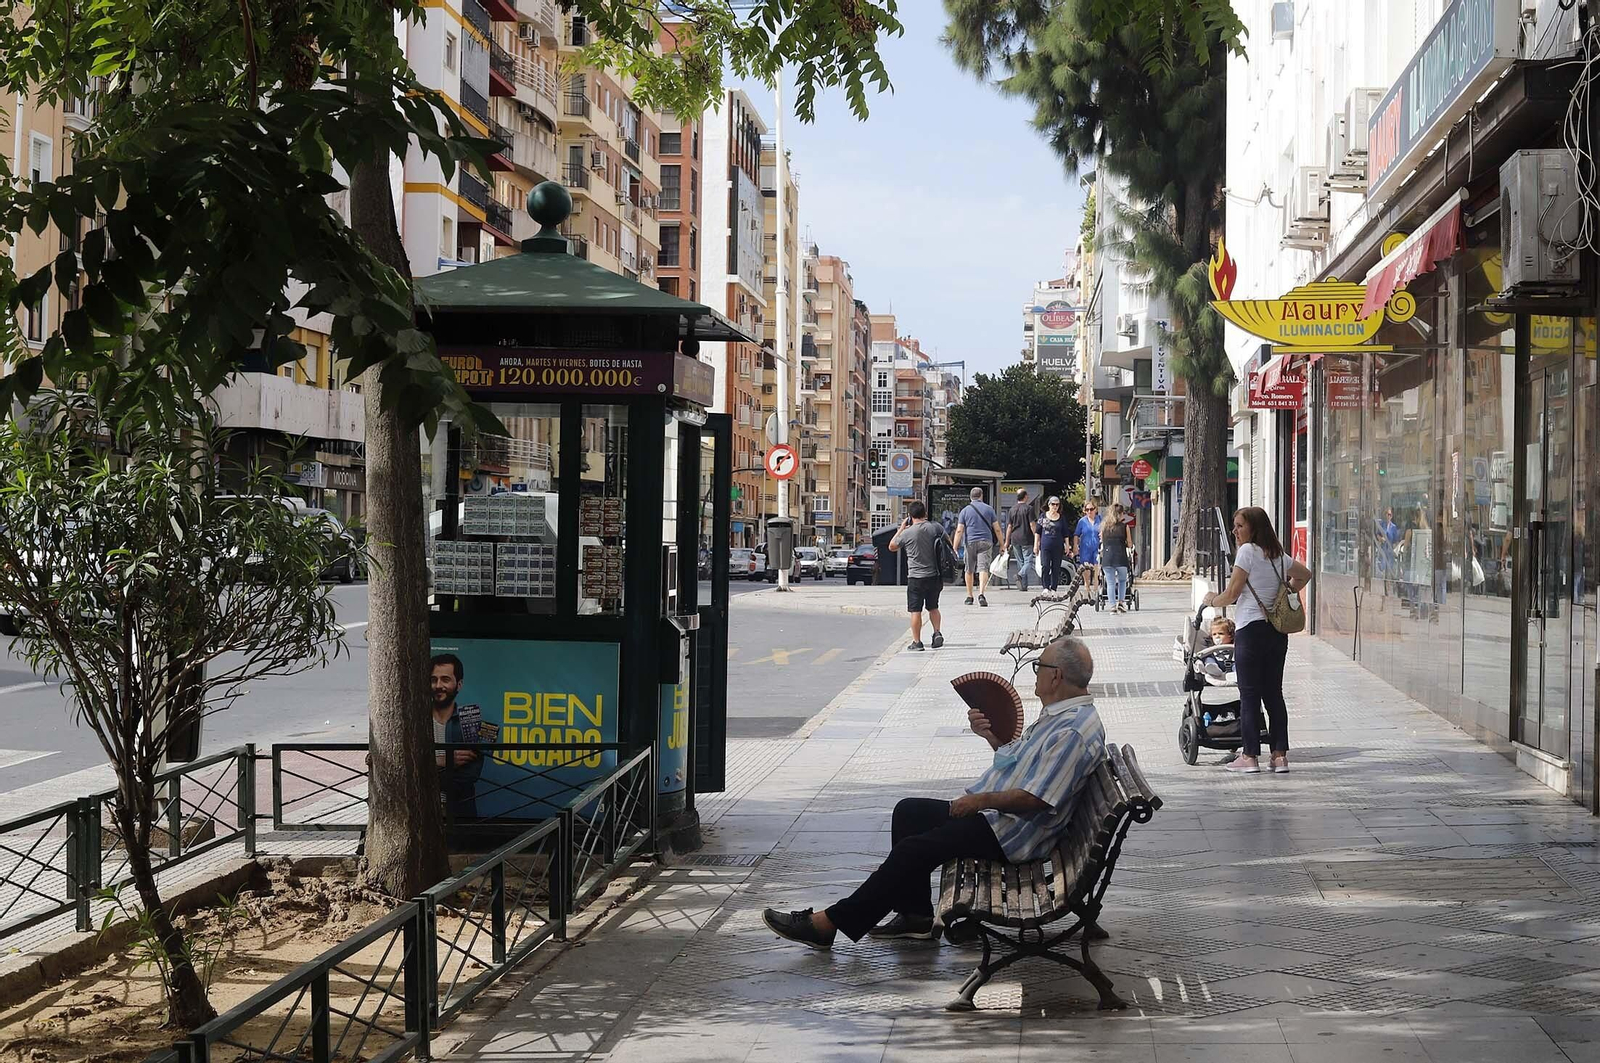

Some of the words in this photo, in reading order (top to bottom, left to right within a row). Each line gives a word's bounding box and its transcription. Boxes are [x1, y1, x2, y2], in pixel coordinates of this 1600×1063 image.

[1369, 86, 1402, 190] MAURY
[1281, 302, 1367, 321] Maury
[1279, 323, 1365, 336] ILUMINACION
[500, 357, 524, 367] AHORA,
[525, 358, 550, 367] MARTES
[551, 358, 558, 367] Y
[559, 358, 588, 368] VIERNES,
[589, 359, 610, 368] BOTES
[612, 359, 621, 368] DE
[622, 359, 643, 369] HASTA
[1041, 358, 1077, 366] HUELVA
[499, 368, 643, 387] 120.000.000€
[503, 691, 603, 727] BIEN
[493, 726, 602, 769] JUGADO
